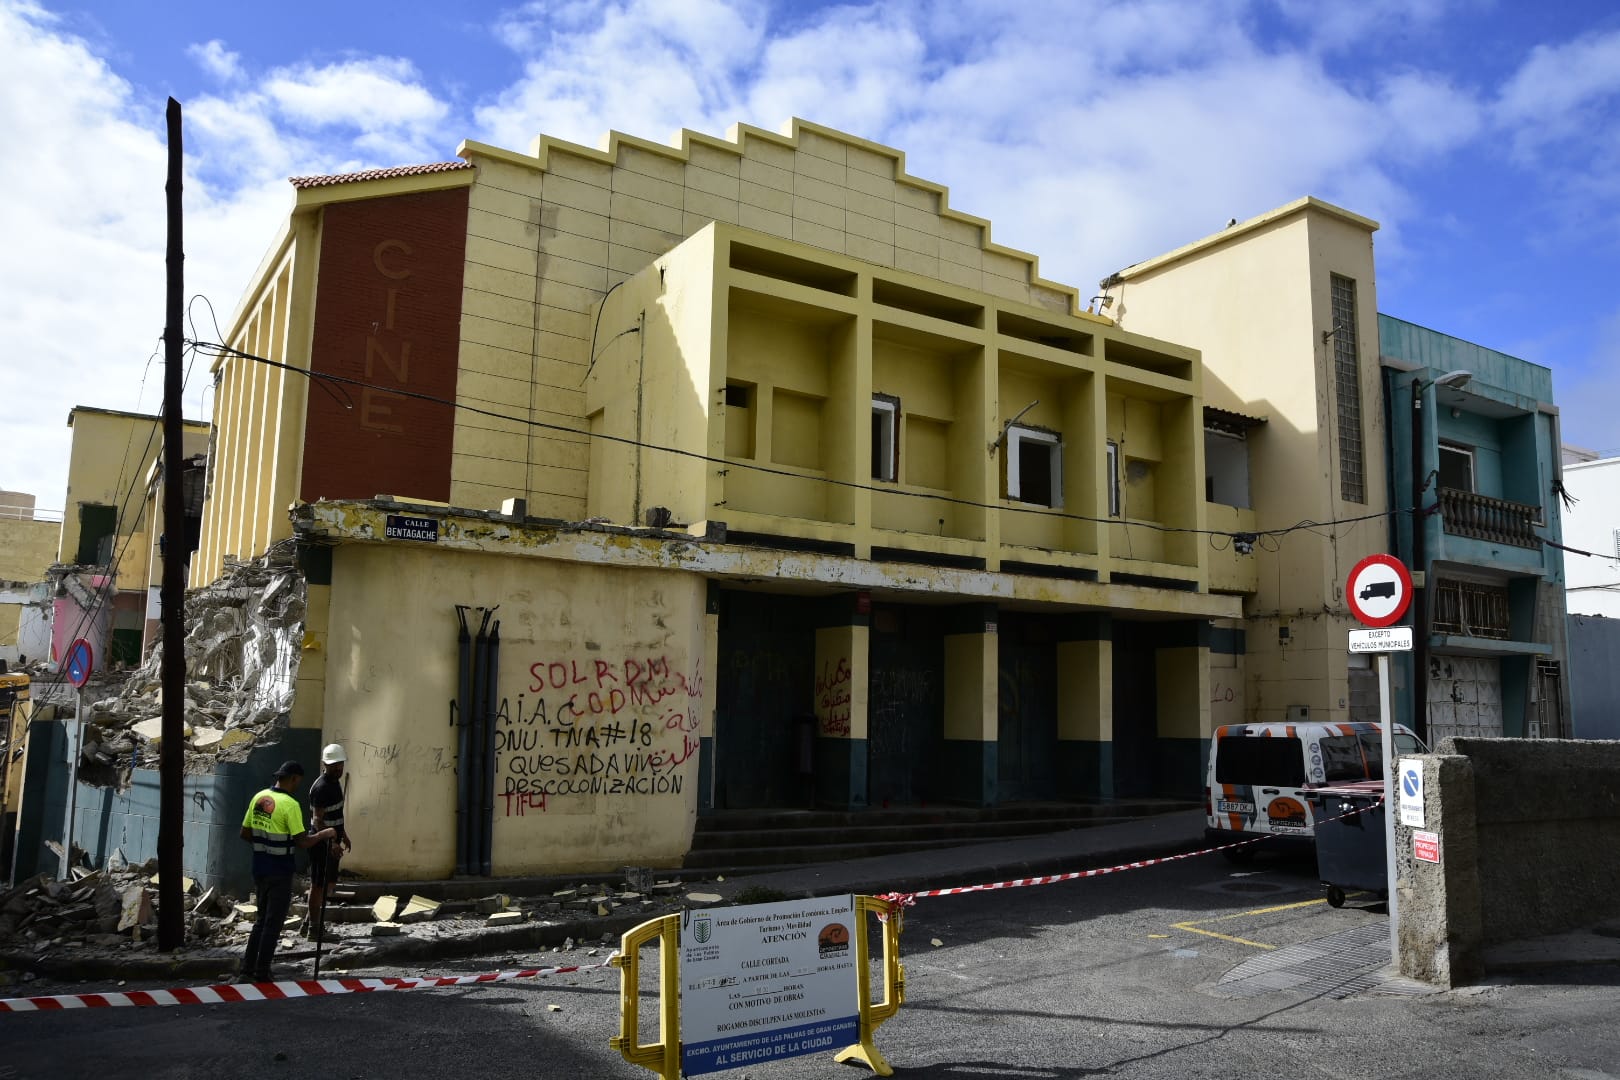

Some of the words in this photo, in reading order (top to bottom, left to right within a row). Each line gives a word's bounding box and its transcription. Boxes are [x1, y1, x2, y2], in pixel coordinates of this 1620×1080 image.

[361, 239, 414, 434] CINE
[405, 520, 430, 528] CALLE
[386, 527, 437, 540] BENTAGACHE
[1368, 630, 1391, 639] EXCEPTO
[1378, 640, 1410, 649] MUNICIPALES
[738, 915, 765, 925] Gobierno
[787, 920, 812, 930] Movilidad
[762, 931, 807, 944] ATENCIÓN
[741, 959, 760, 969] CALLE
[761, 956, 789, 967] CORTADA
[749, 972, 770, 982] PARTIR
[728, 1001, 743, 1010] CON
[744, 997, 771, 1008] MOTIVO
[773, 995, 783, 1004] DE
[783, 992, 805, 1002] OBRAS
[717, 1020, 748, 1032] ROGAMOS
[749, 1015, 781, 1027] DISCULPEN
[782, 1013, 793, 1021] LAS
[793, 1008, 826, 1019] MOLESTIAS
[687, 1047, 711, 1056] EXCMO.
[712, 1038, 761, 1053] AYUNTAMIENTO
[771, 1034, 783, 1042] LAS
[783, 1030, 806, 1040] PALMAS
[807, 1028, 816, 1036] DE
[815, 1026, 832, 1034] GRAN
[716, 1055, 729, 1066] AL
[730, 1046, 772, 1063] SERVICIO
[774, 1045, 786, 1055] DE
[788, 1042, 800, 1052] LA
[801, 1036, 833, 1050] CIUDAD
